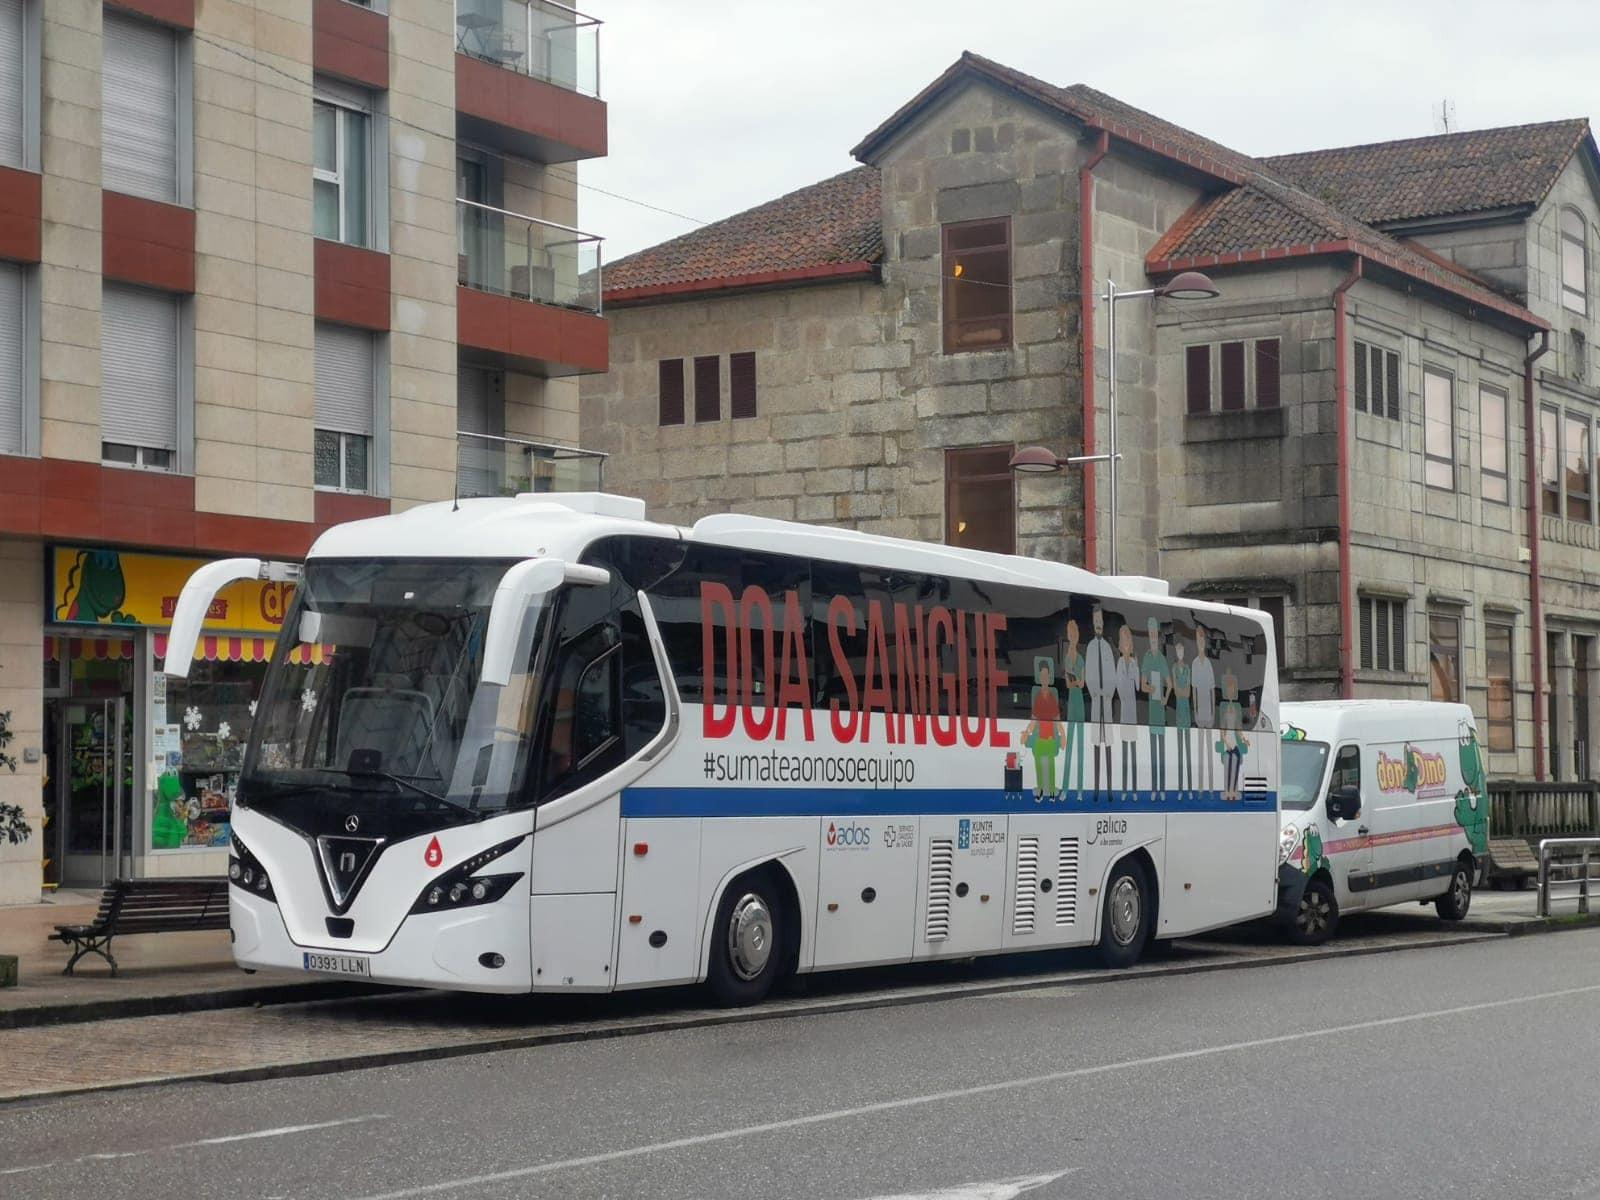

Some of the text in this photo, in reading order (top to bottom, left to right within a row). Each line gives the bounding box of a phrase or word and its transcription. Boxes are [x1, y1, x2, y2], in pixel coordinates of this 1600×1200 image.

[701, 581, 1010, 747] DOA SANGUE
[703, 749, 915, 790] #sumateaonosoequipo
[837, 821, 870, 845] ados
[1087, 816, 1127, 845] galicia
[310, 955, 364, 973] 0393 LLN
